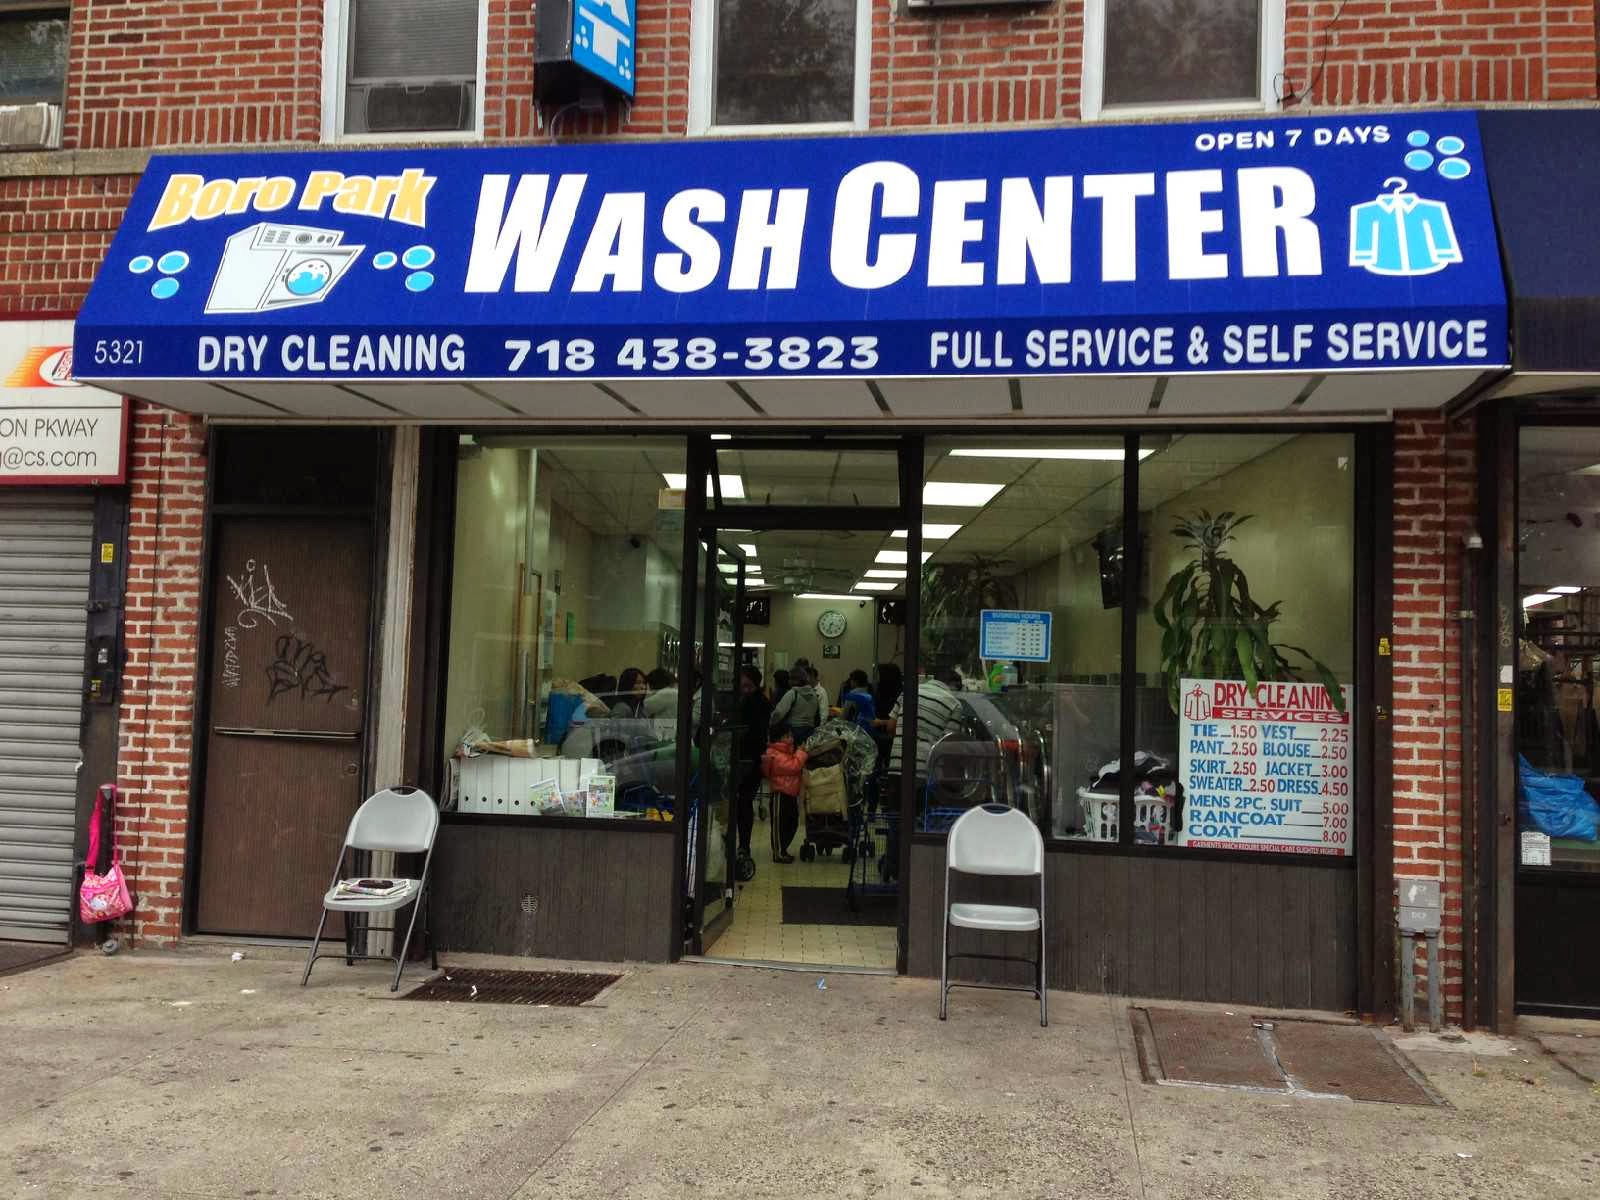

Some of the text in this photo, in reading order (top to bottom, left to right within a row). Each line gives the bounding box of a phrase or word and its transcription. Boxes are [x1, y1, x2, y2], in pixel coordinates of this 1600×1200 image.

[1195, 125, 1391, 151] OPEN 7 DAYS
[464, 161, 1322, 293] WASH CENTER
[95, 339, 143, 364] 5321
[198, 334, 465, 372] DRY CLEANING
[504, 336, 879, 371] 718 438-3823
[930, 319, 1487, 369] FULL SERVICE & SELF SERVICE
[35, 418, 98, 438] PKWAY
[0, 447, 97, 469] @cs.com
[1214, 682, 1248, 706] DRY
[1222, 709, 1344, 722] SERVICES
[1190, 724, 1348, 743] TIE 1.50 VEST 2.25
[1190, 740, 1347, 760] PANT 2.50 BLOUSE 2.50
[1190, 759, 1347, 778] SKIRT 2.50 JACKET 3.00
[1189, 775, 1348, 796] SWEATER 2.50 DRESS 4.50
[1189, 794, 1348, 815] MENS 2PC. SUIT 5.00
[1190, 810, 1347, 829] RAINCOAT 7.00
[1188, 824, 1347, 843] COAT 8.00
